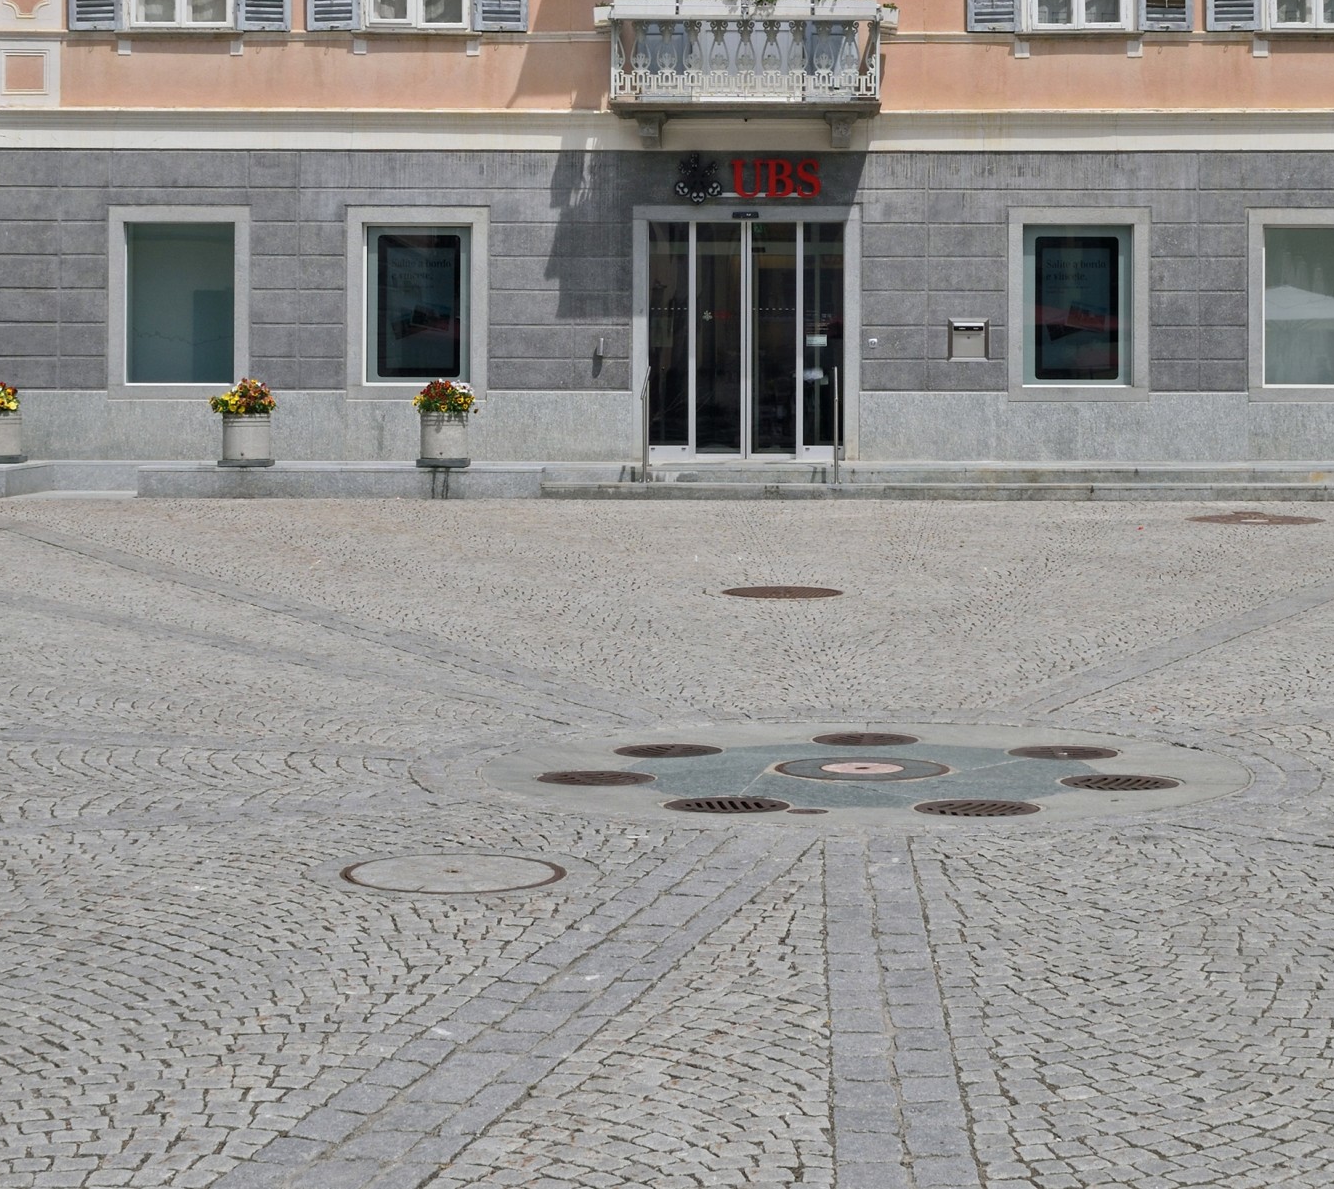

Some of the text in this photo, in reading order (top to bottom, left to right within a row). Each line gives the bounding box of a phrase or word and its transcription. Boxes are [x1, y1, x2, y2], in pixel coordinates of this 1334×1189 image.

[730, 158, 823, 200] UBS
[426, 259, 451, 268] bordo
[1046, 260, 1070, 269] Salite
[1080, 260, 1107, 269] bordo
